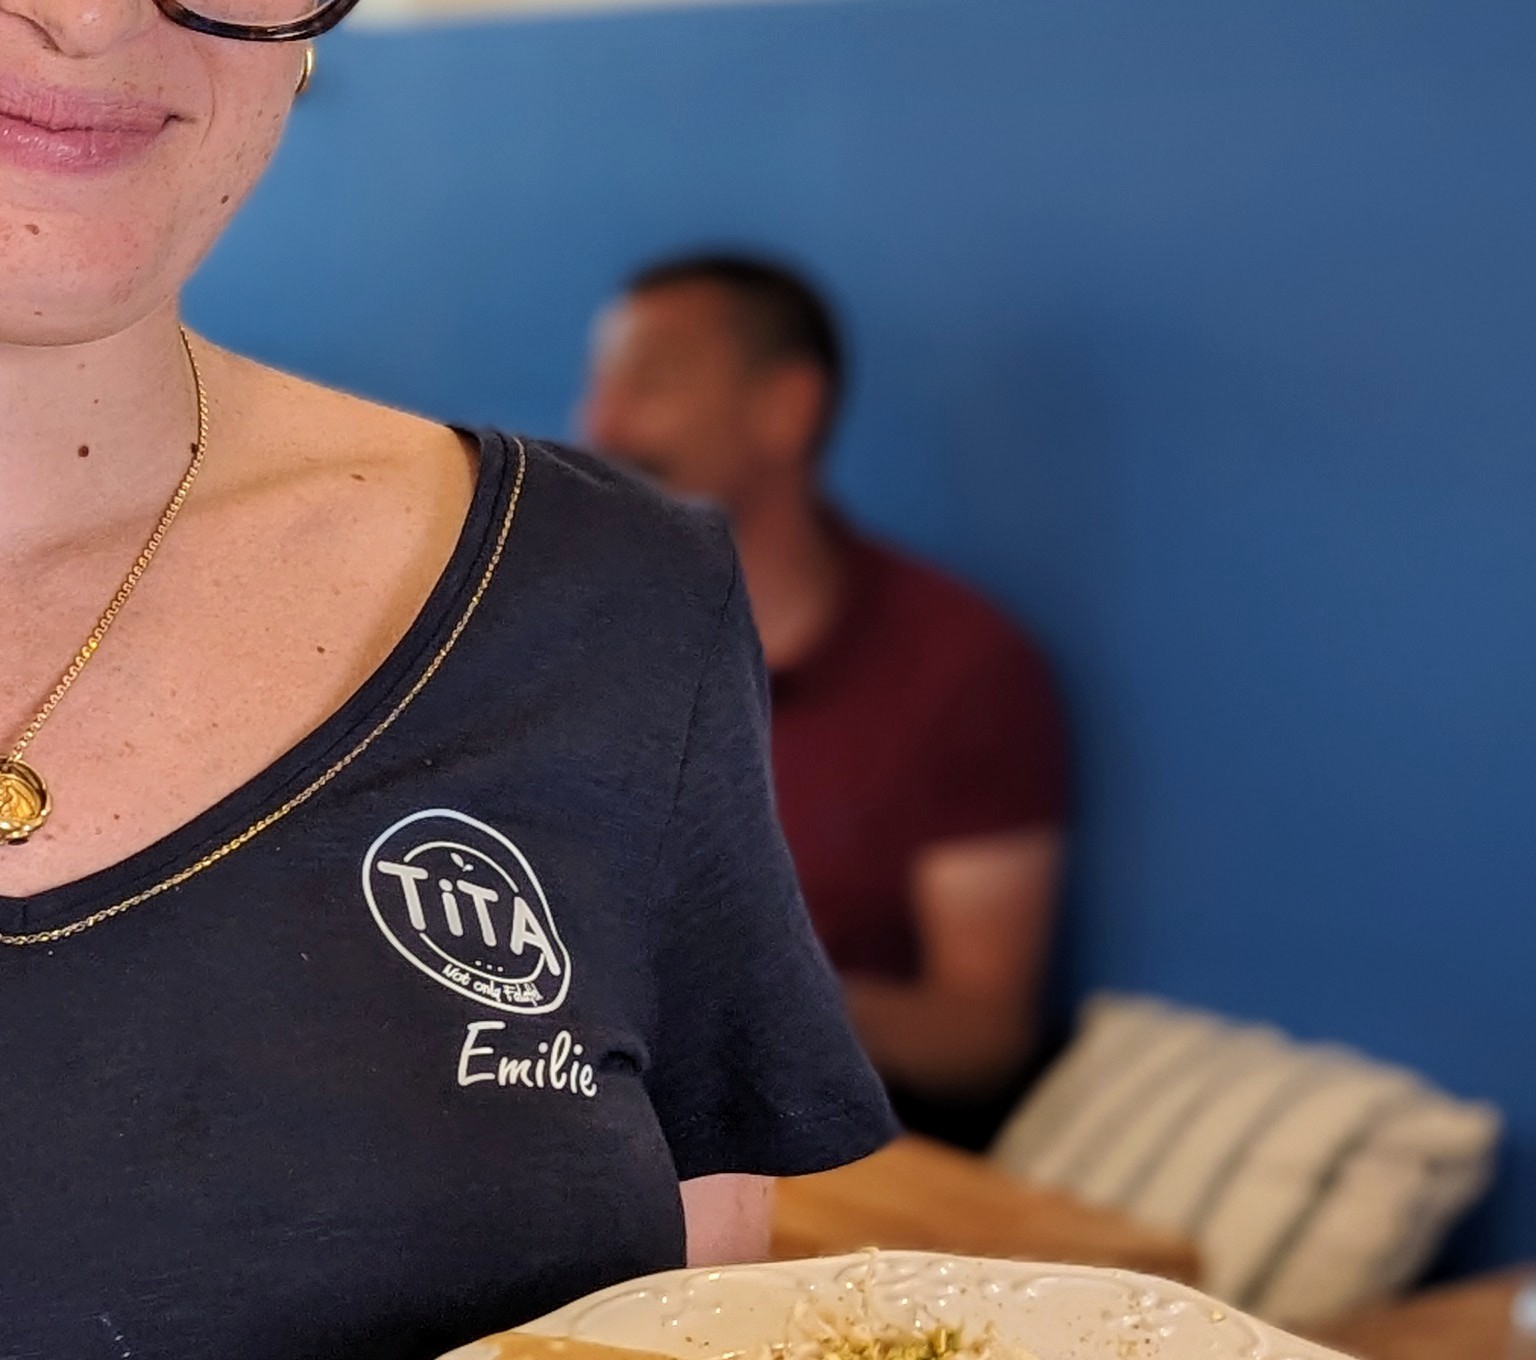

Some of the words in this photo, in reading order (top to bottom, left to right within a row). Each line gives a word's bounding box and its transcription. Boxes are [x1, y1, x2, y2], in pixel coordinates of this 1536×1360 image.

[441, 963, 472, 986] Not
[472, 980, 501, 1003] only
[456, 1020, 599, 1098] Emilie
